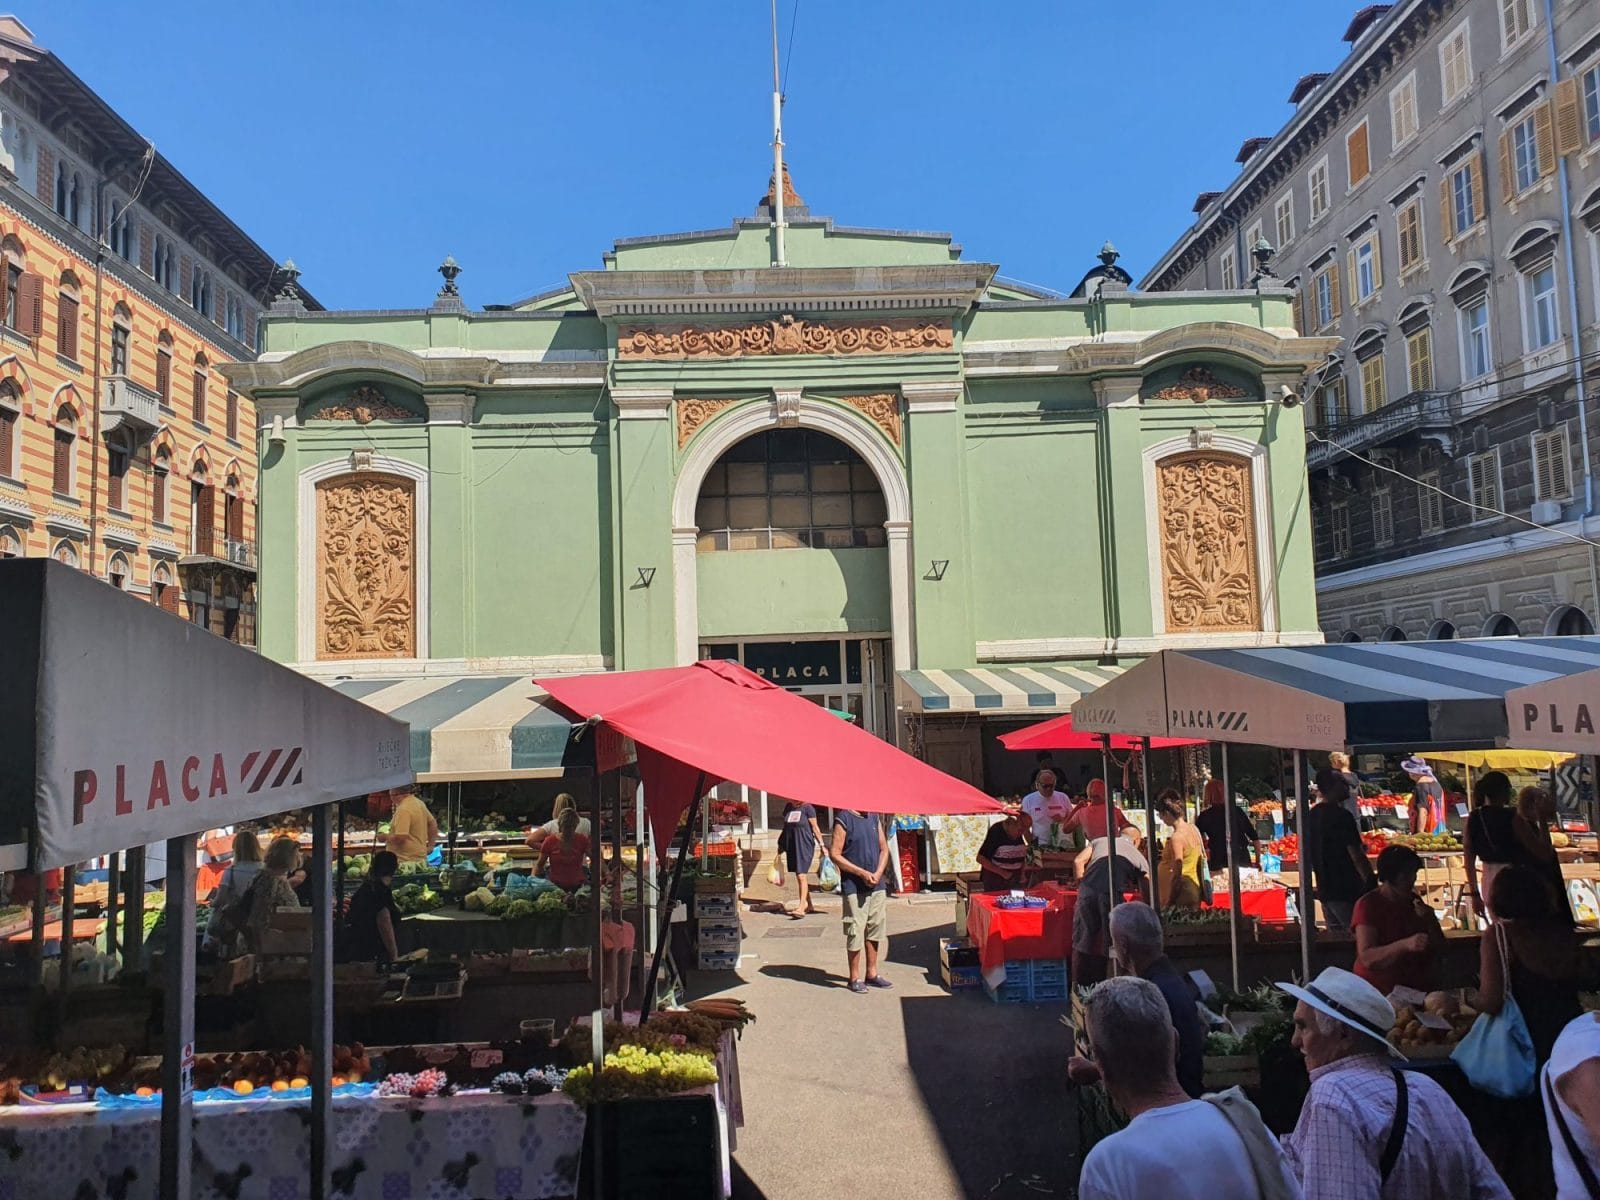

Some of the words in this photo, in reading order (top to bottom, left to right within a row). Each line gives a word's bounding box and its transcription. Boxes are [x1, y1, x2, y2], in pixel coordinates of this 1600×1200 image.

[756, 665, 829, 678] PLACA
[1172, 710, 1214, 729] PLACA
[1523, 703, 1595, 734] PLA
[73, 752, 228, 826] PLACA
